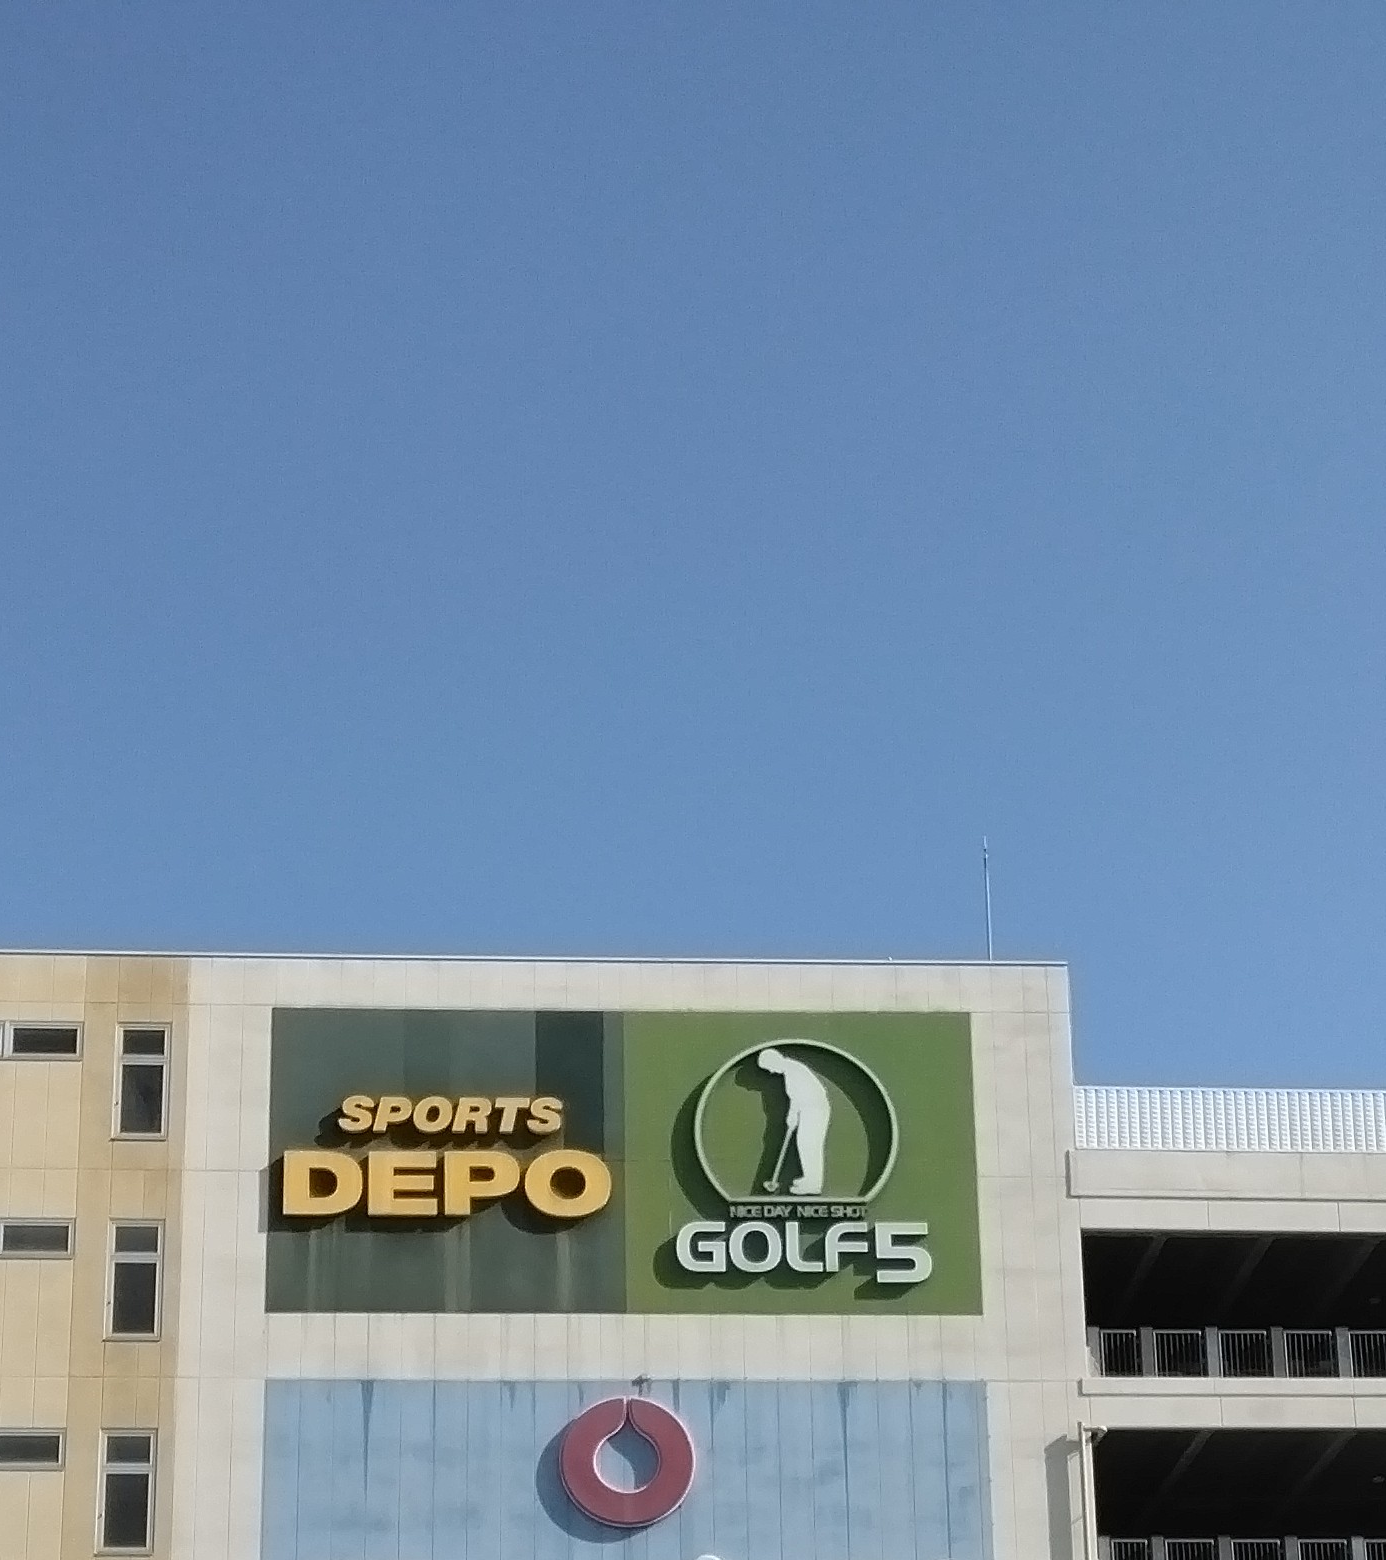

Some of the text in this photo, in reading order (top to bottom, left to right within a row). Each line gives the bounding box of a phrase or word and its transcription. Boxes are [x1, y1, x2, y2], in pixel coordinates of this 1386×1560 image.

[338, 1095, 564, 1134] SPORTS
[281, 1149, 612, 1218] DEPO
[730, 1205, 867, 1218] NICE DAY NICE SHOT
[676, 1221, 932, 1283] GOLF5
